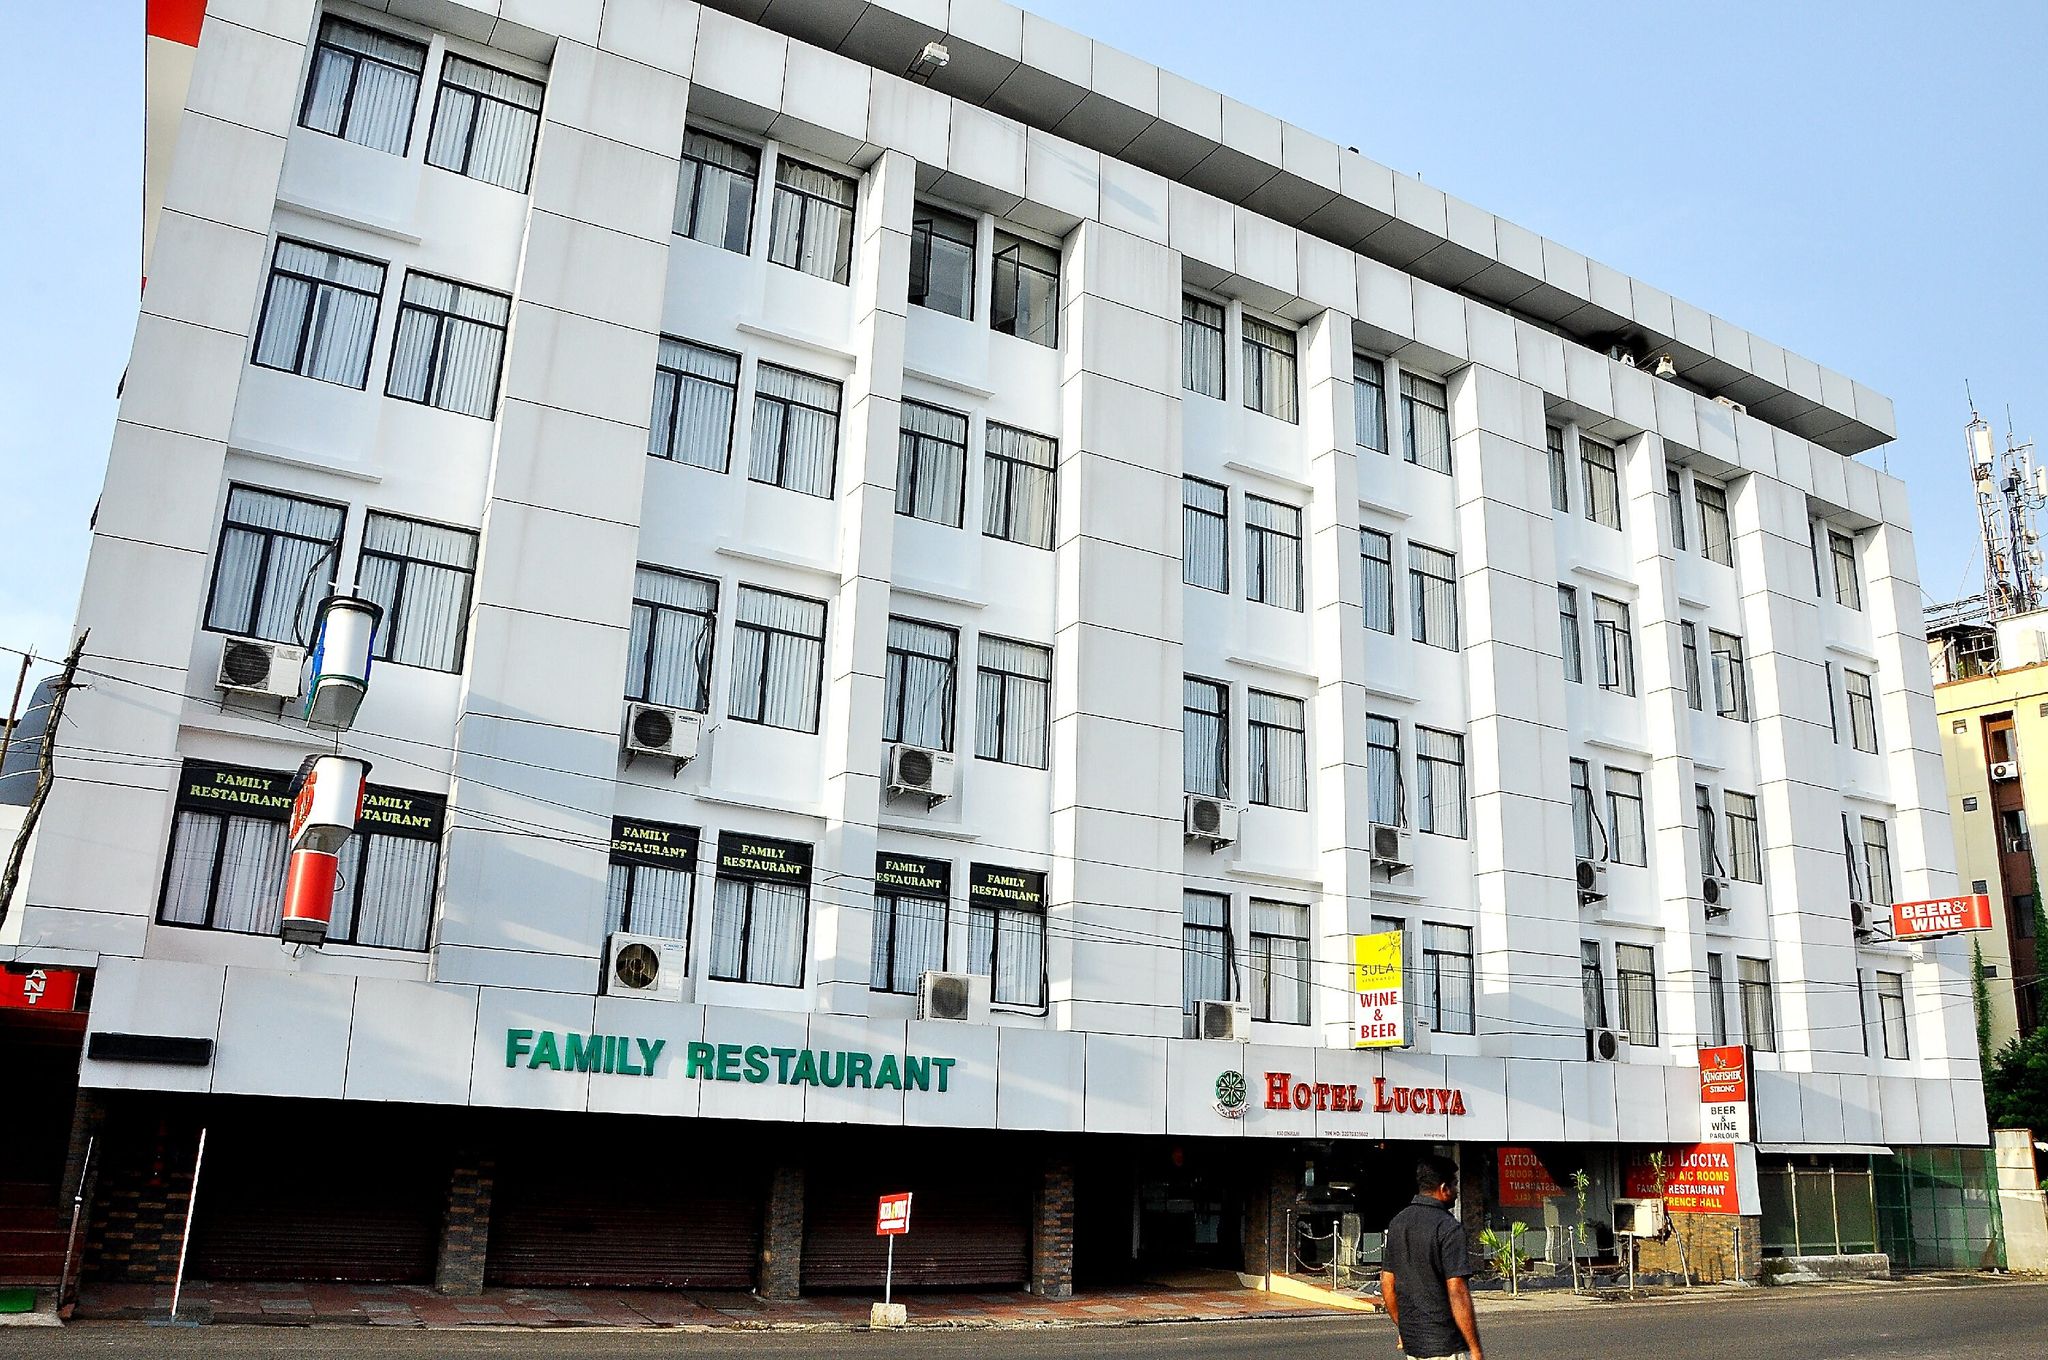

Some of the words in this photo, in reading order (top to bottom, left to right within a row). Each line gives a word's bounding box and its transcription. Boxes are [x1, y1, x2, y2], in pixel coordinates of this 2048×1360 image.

[215, 772, 273, 791] FAMILY
[190, 784, 293, 809] RESTAURANT
[622, 826, 671, 842] FAMILY
[610, 839, 688, 859] ESTAURANT
[741, 844, 786, 860] FAMILY
[723, 855, 802, 875] RESTAURANT
[885, 860, 926, 874] FAMILY
[876, 871, 942, 889] ESTAURANT
[987, 874, 1026, 888] FAMILY
[971, 884, 1041, 903] RESTAURANT
[1911, 914, 1963, 932] WINE
[1361, 963, 1395, 976] SULA
[1360, 991, 1398, 1008] WINE
[1373, 1008, 1383, 1021] &
[1360, 1022, 1397, 1039] BEER
[504, 1027, 667, 1078] FAMILY
[685, 1041, 957, 1093] RESTAURANT
[1702, 1070, 1742, 1083] KINGFISHER
[1709, 1085, 1736, 1094] STRONG
[1710, 1105, 1736, 1115] BEER
[1711, 1121, 1737, 1132] WINE
[1709, 1132, 1740, 1140] PARLOUR
[1680, 1149, 1729, 1168] LUCIYA
[1679, 1170, 1694, 1182] A/C
[1696, 1170, 1729, 1182] ROOMS
[1668, 1184, 1726, 1196] RESTAURANT
[1699, 1197, 1722, 1208] HALL
